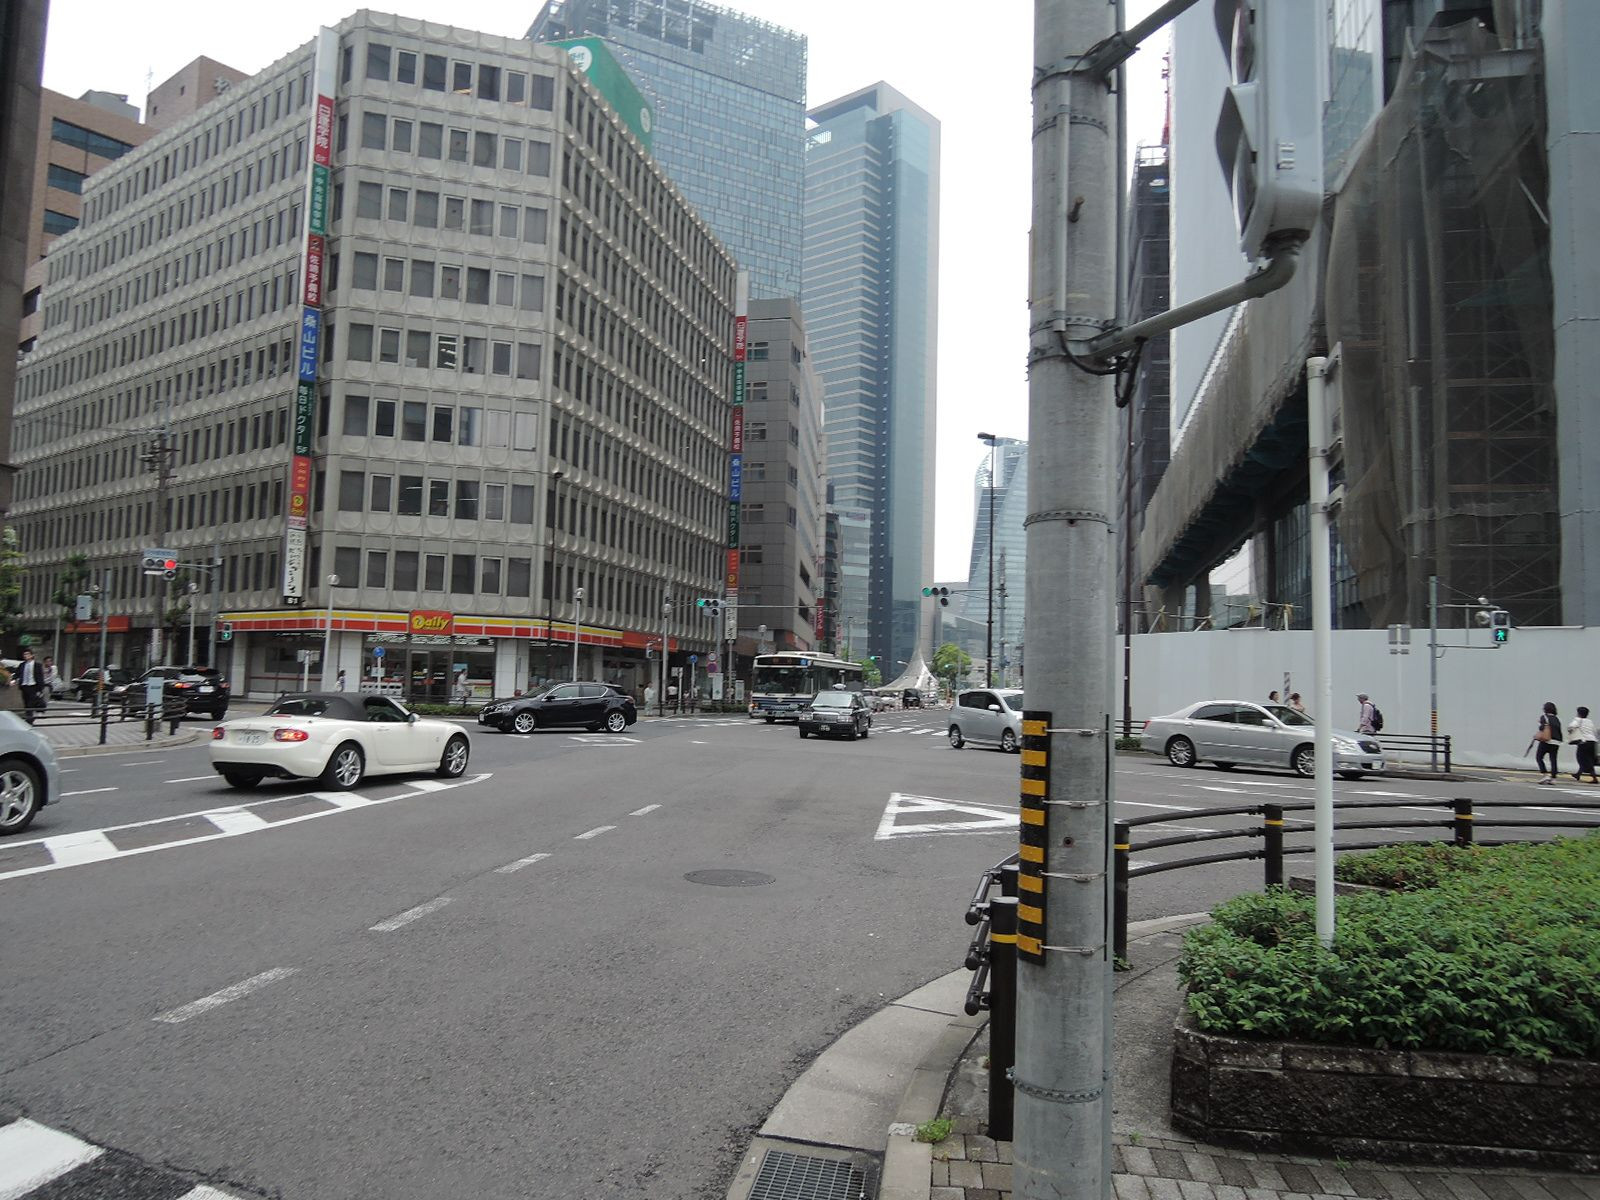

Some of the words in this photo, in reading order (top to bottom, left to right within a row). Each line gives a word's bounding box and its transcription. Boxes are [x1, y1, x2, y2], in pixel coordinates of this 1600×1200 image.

[301, 314, 317, 375] 桑山ビル
[296, 385, 308, 444] 毎日ドクター
[412, 615, 450, 631] Daily
